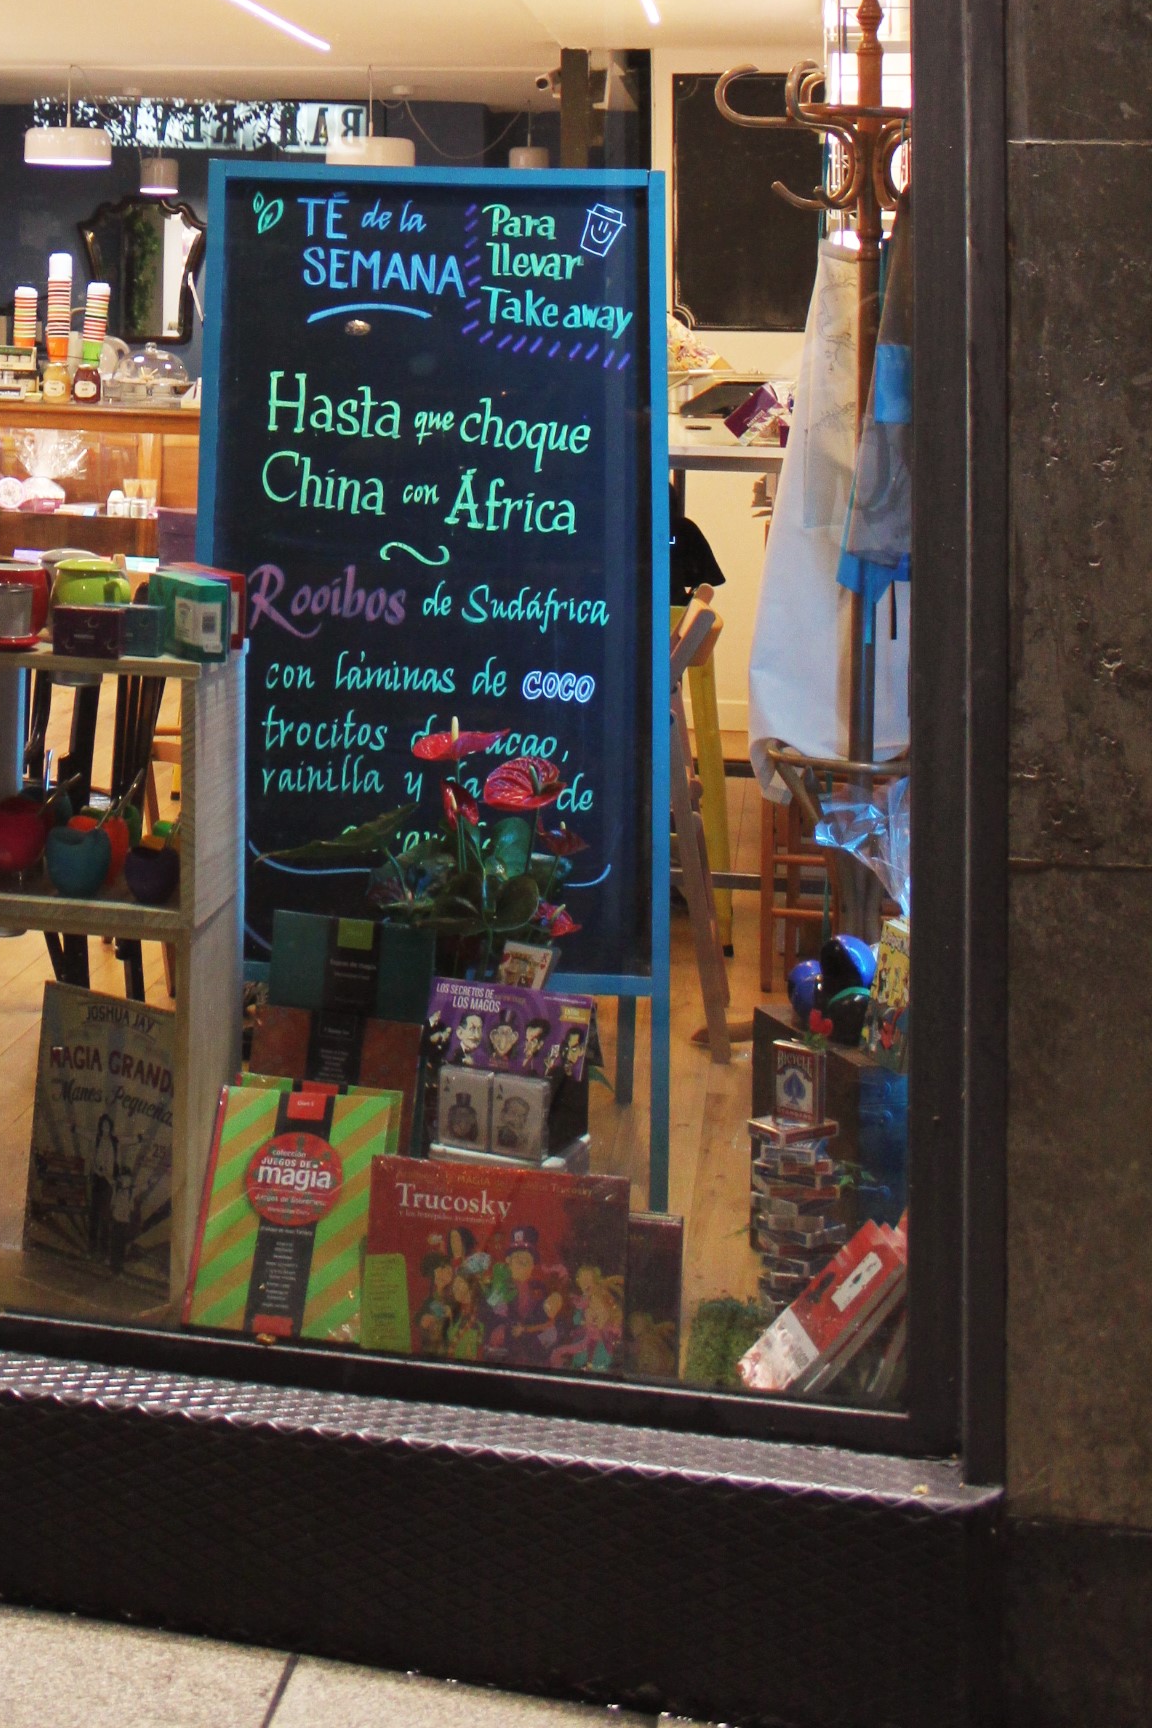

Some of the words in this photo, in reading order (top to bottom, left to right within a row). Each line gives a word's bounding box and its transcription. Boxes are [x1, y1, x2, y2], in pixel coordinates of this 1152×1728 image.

[297, 191, 350, 240] TÉ
[361, 198, 391, 229] de
[400, 199, 427, 234] la
[481, 203, 557, 240] Para
[302, 247, 467, 298] SEMANA
[485, 242, 585, 281] llevar
[480, 286, 559, 329] Take
[562, 306, 634, 340] away
[267, 370, 402, 440] Hasta
[414, 407, 455, 445] que
[458, 397, 592, 473] choque
[261, 450, 386, 516] China
[402, 483, 440, 505] con
[443, 467, 578, 535] África
[422, 579, 452, 617] de
[461, 583, 611, 633] Sudáfrica
[265, 662, 316, 690] con
[335, 650, 457, 694] láminas
[472, 656, 508, 697] de
[522, 669, 596, 704] coco
[261, 704, 389, 752] trocitos
[404, 772, 424, 802] y
[556, 772, 595, 812] de
[436, 982, 450, 993] LOS
[450, 984, 485, 998] SECRETOS
[485, 988, 495, 1000] DE
[452, 996, 469, 1009] LOS
[470, 998, 501, 1013] MAGOS
[86, 1004, 130, 1024] JOSHUA
[50, 1045, 102, 1072] MAGIA
[109, 1049, 174, 1098] GRAND
[778, 1050, 812, 1075] BICYCLE
[257, 1164, 332, 1192] magia
[261, 1157, 297, 1168] JUEGOS
[299, 1159, 312, 1168] DE
[394, 1182, 512, 1218] Trucosky
